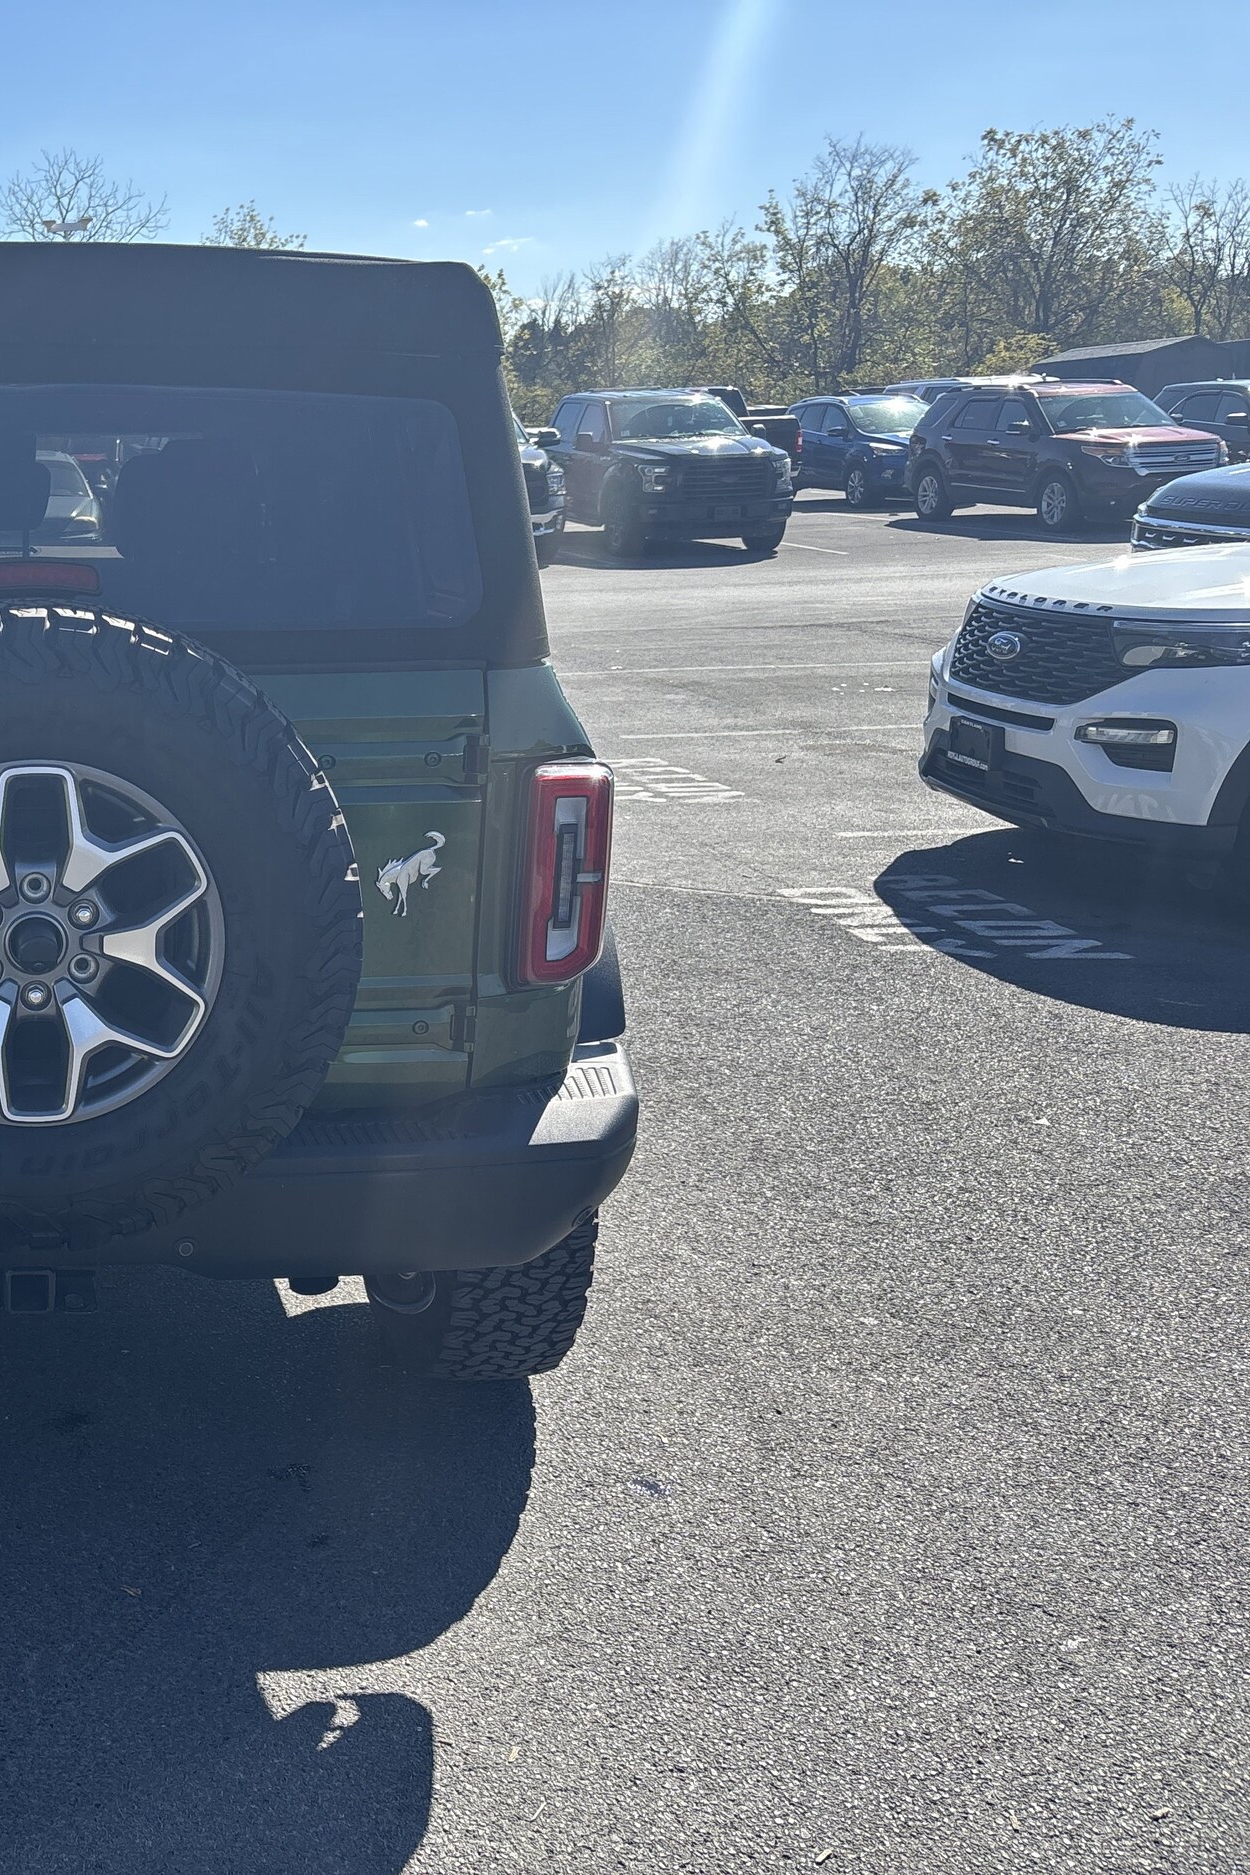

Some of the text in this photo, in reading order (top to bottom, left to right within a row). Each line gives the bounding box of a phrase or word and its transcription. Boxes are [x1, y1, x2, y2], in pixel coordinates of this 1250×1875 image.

[1161, 495, 1221, 510] SUPER
[989, 586, 1113, 612] EXPLORER
[868, 874, 1138, 960] RECON
